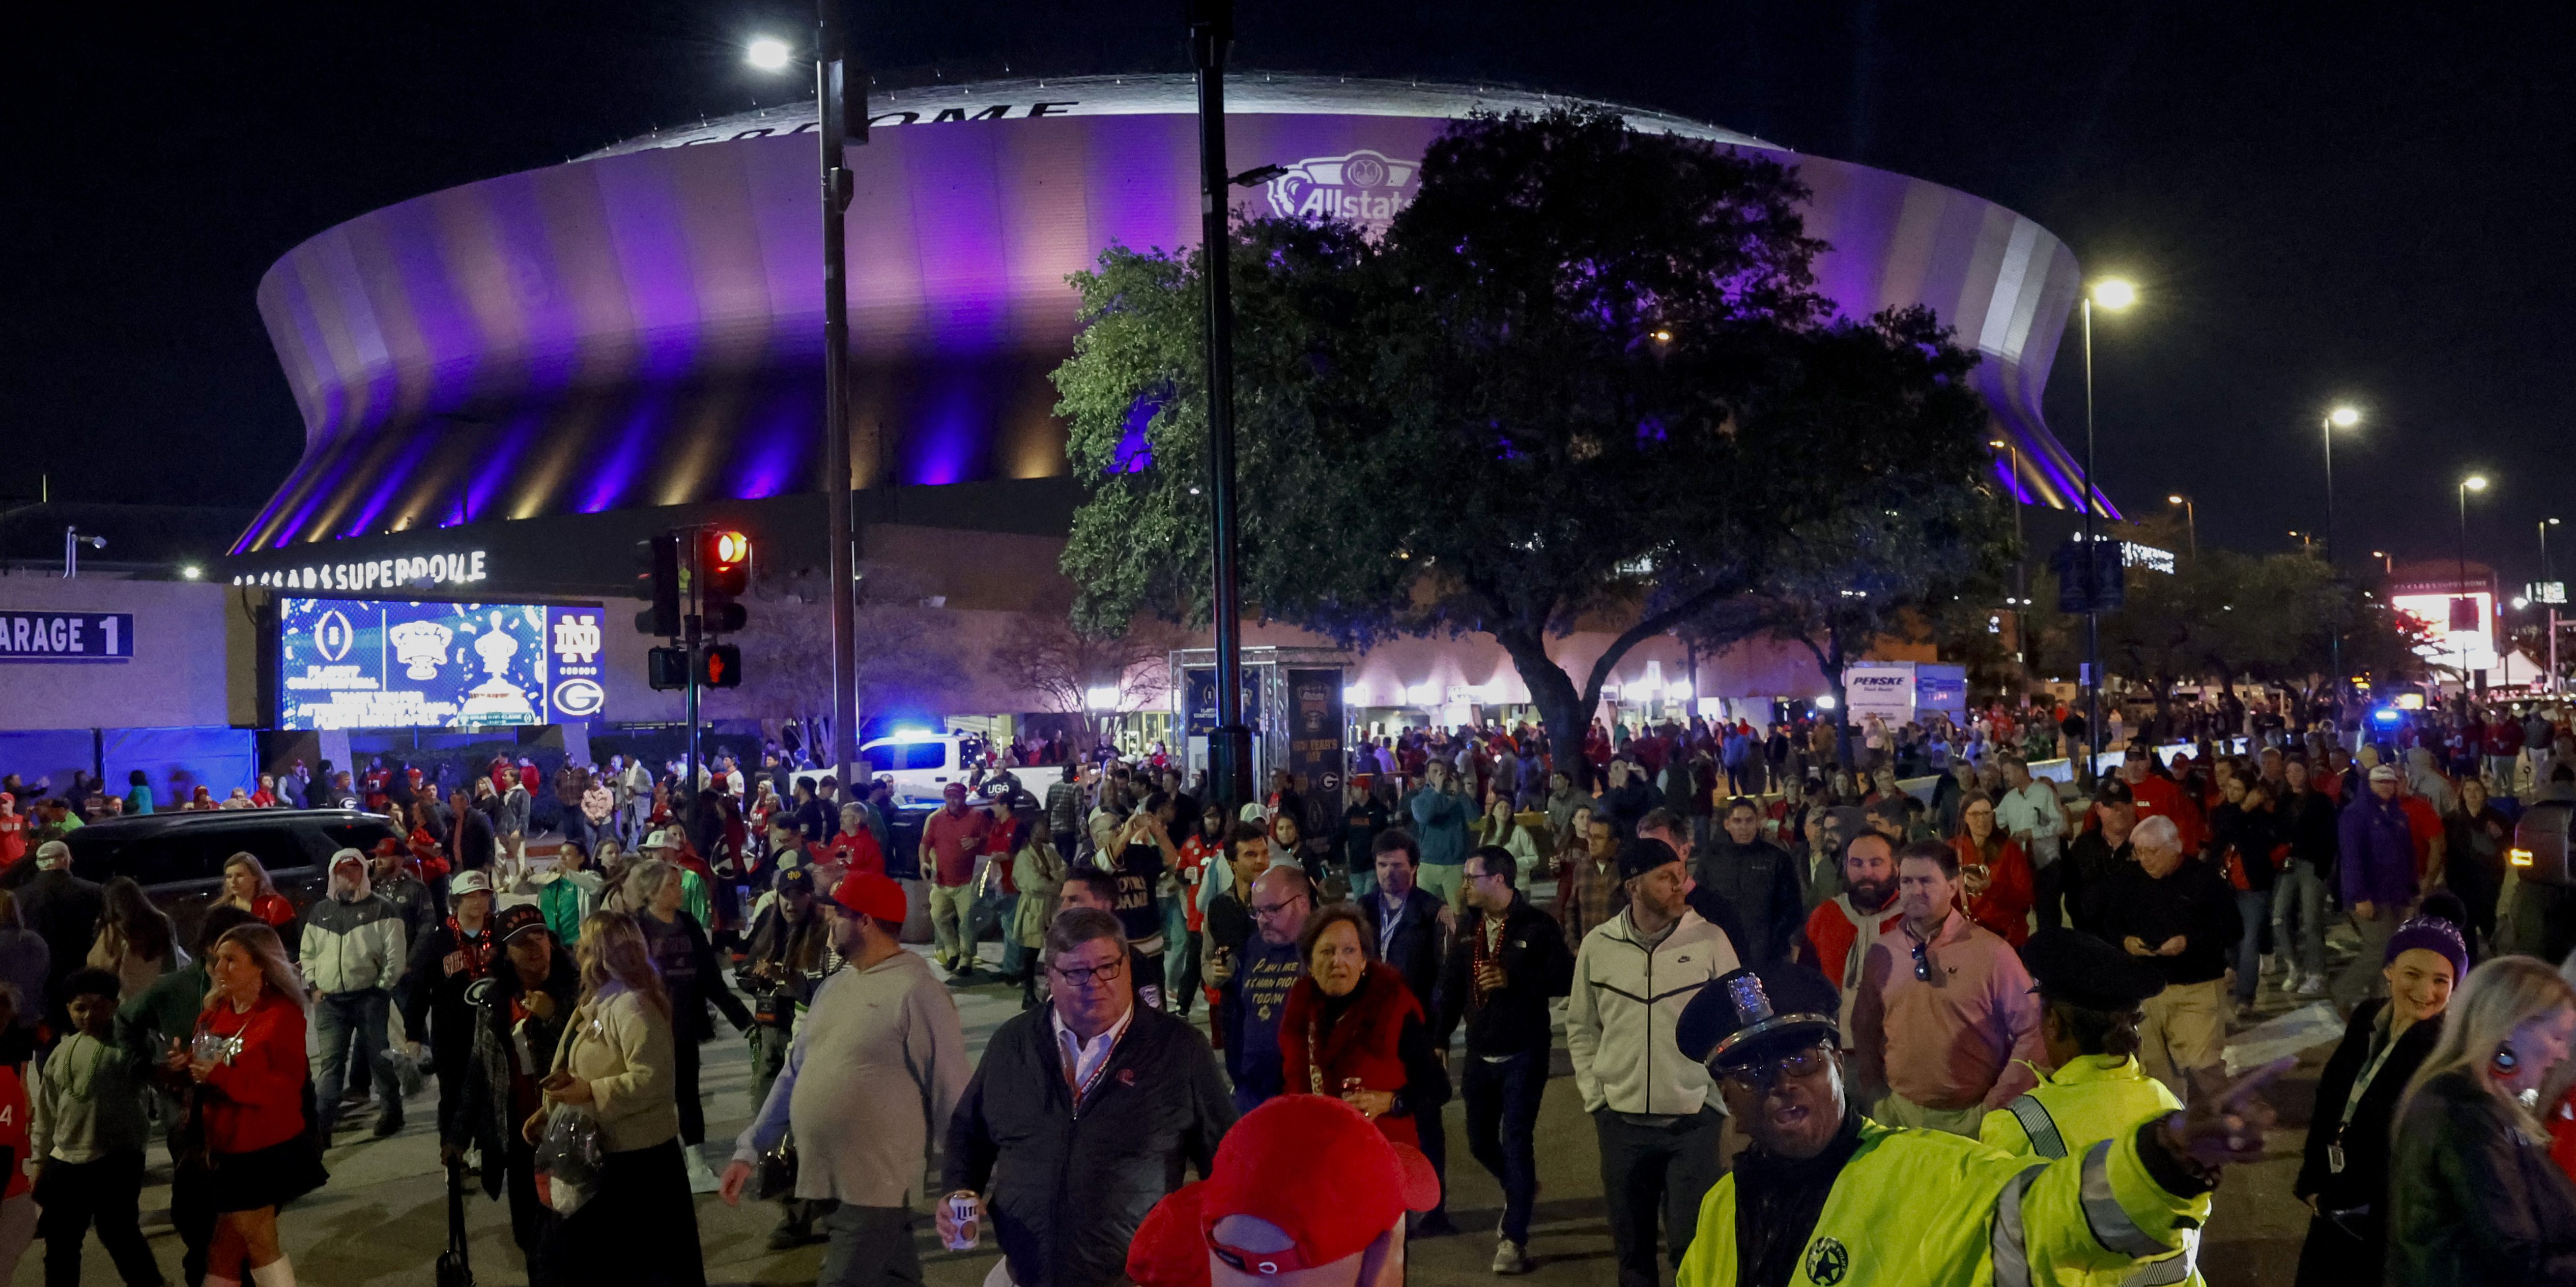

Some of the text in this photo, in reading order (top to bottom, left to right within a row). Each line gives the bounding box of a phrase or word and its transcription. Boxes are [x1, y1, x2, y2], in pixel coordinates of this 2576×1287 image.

[99, 616, 118, 655] 1
[1853, 677, 1905, 685] PENSKE
[988, 783, 1010, 794] UGA
